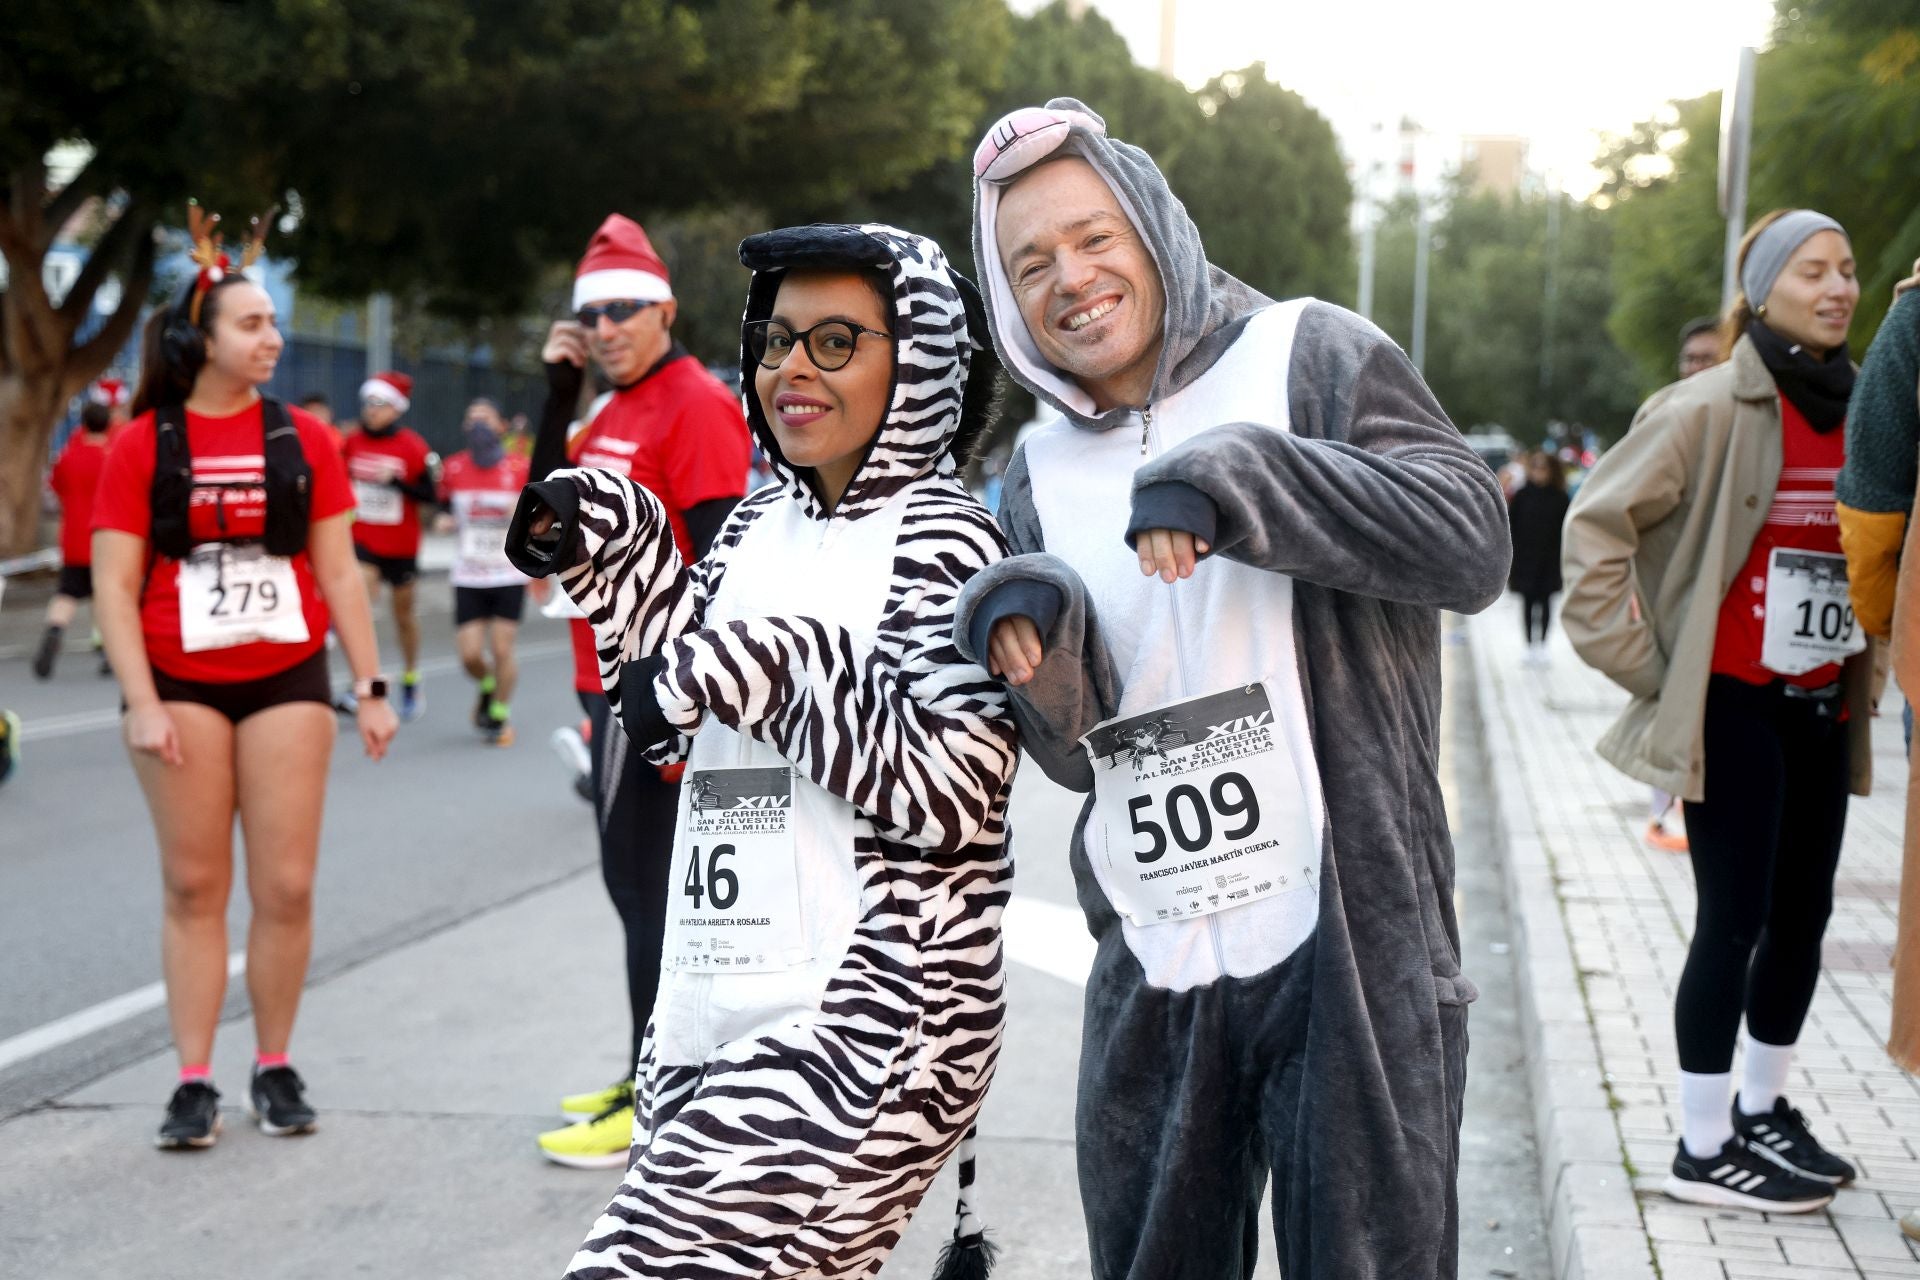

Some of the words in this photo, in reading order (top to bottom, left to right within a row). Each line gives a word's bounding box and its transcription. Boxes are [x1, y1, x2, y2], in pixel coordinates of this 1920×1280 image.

[209, 579, 279, 617] 279
[1794, 599, 1855, 641] 109
[1194, 726, 1270, 752] CARRERA
[1205, 710, 1271, 740] XIV
[1135, 765, 1182, 782] PALMA
[1190, 740, 1274, 768] PALMILLA
[1159, 756, 1187, 768] SAN
[1191, 734, 1272, 760] SILVESTRE
[1201, 759, 1229, 769] CIUDAD
[722, 809, 786, 817] CARRERA
[732, 795, 790, 809] XIV
[1128, 771, 1260, 864] 509
[715, 823, 786, 831] PALMILLA
[684, 843, 739, 910] 46
[1139, 867, 1178, 882] FRANCISCO
[1179, 859, 1210, 874] JAVIER
[1210, 848, 1244, 866] MARTÍN
[1244, 839, 1280, 855] CUENCA
[707, 918, 735, 926] ARRIETA
[736, 918, 771, 926] ROSALES
